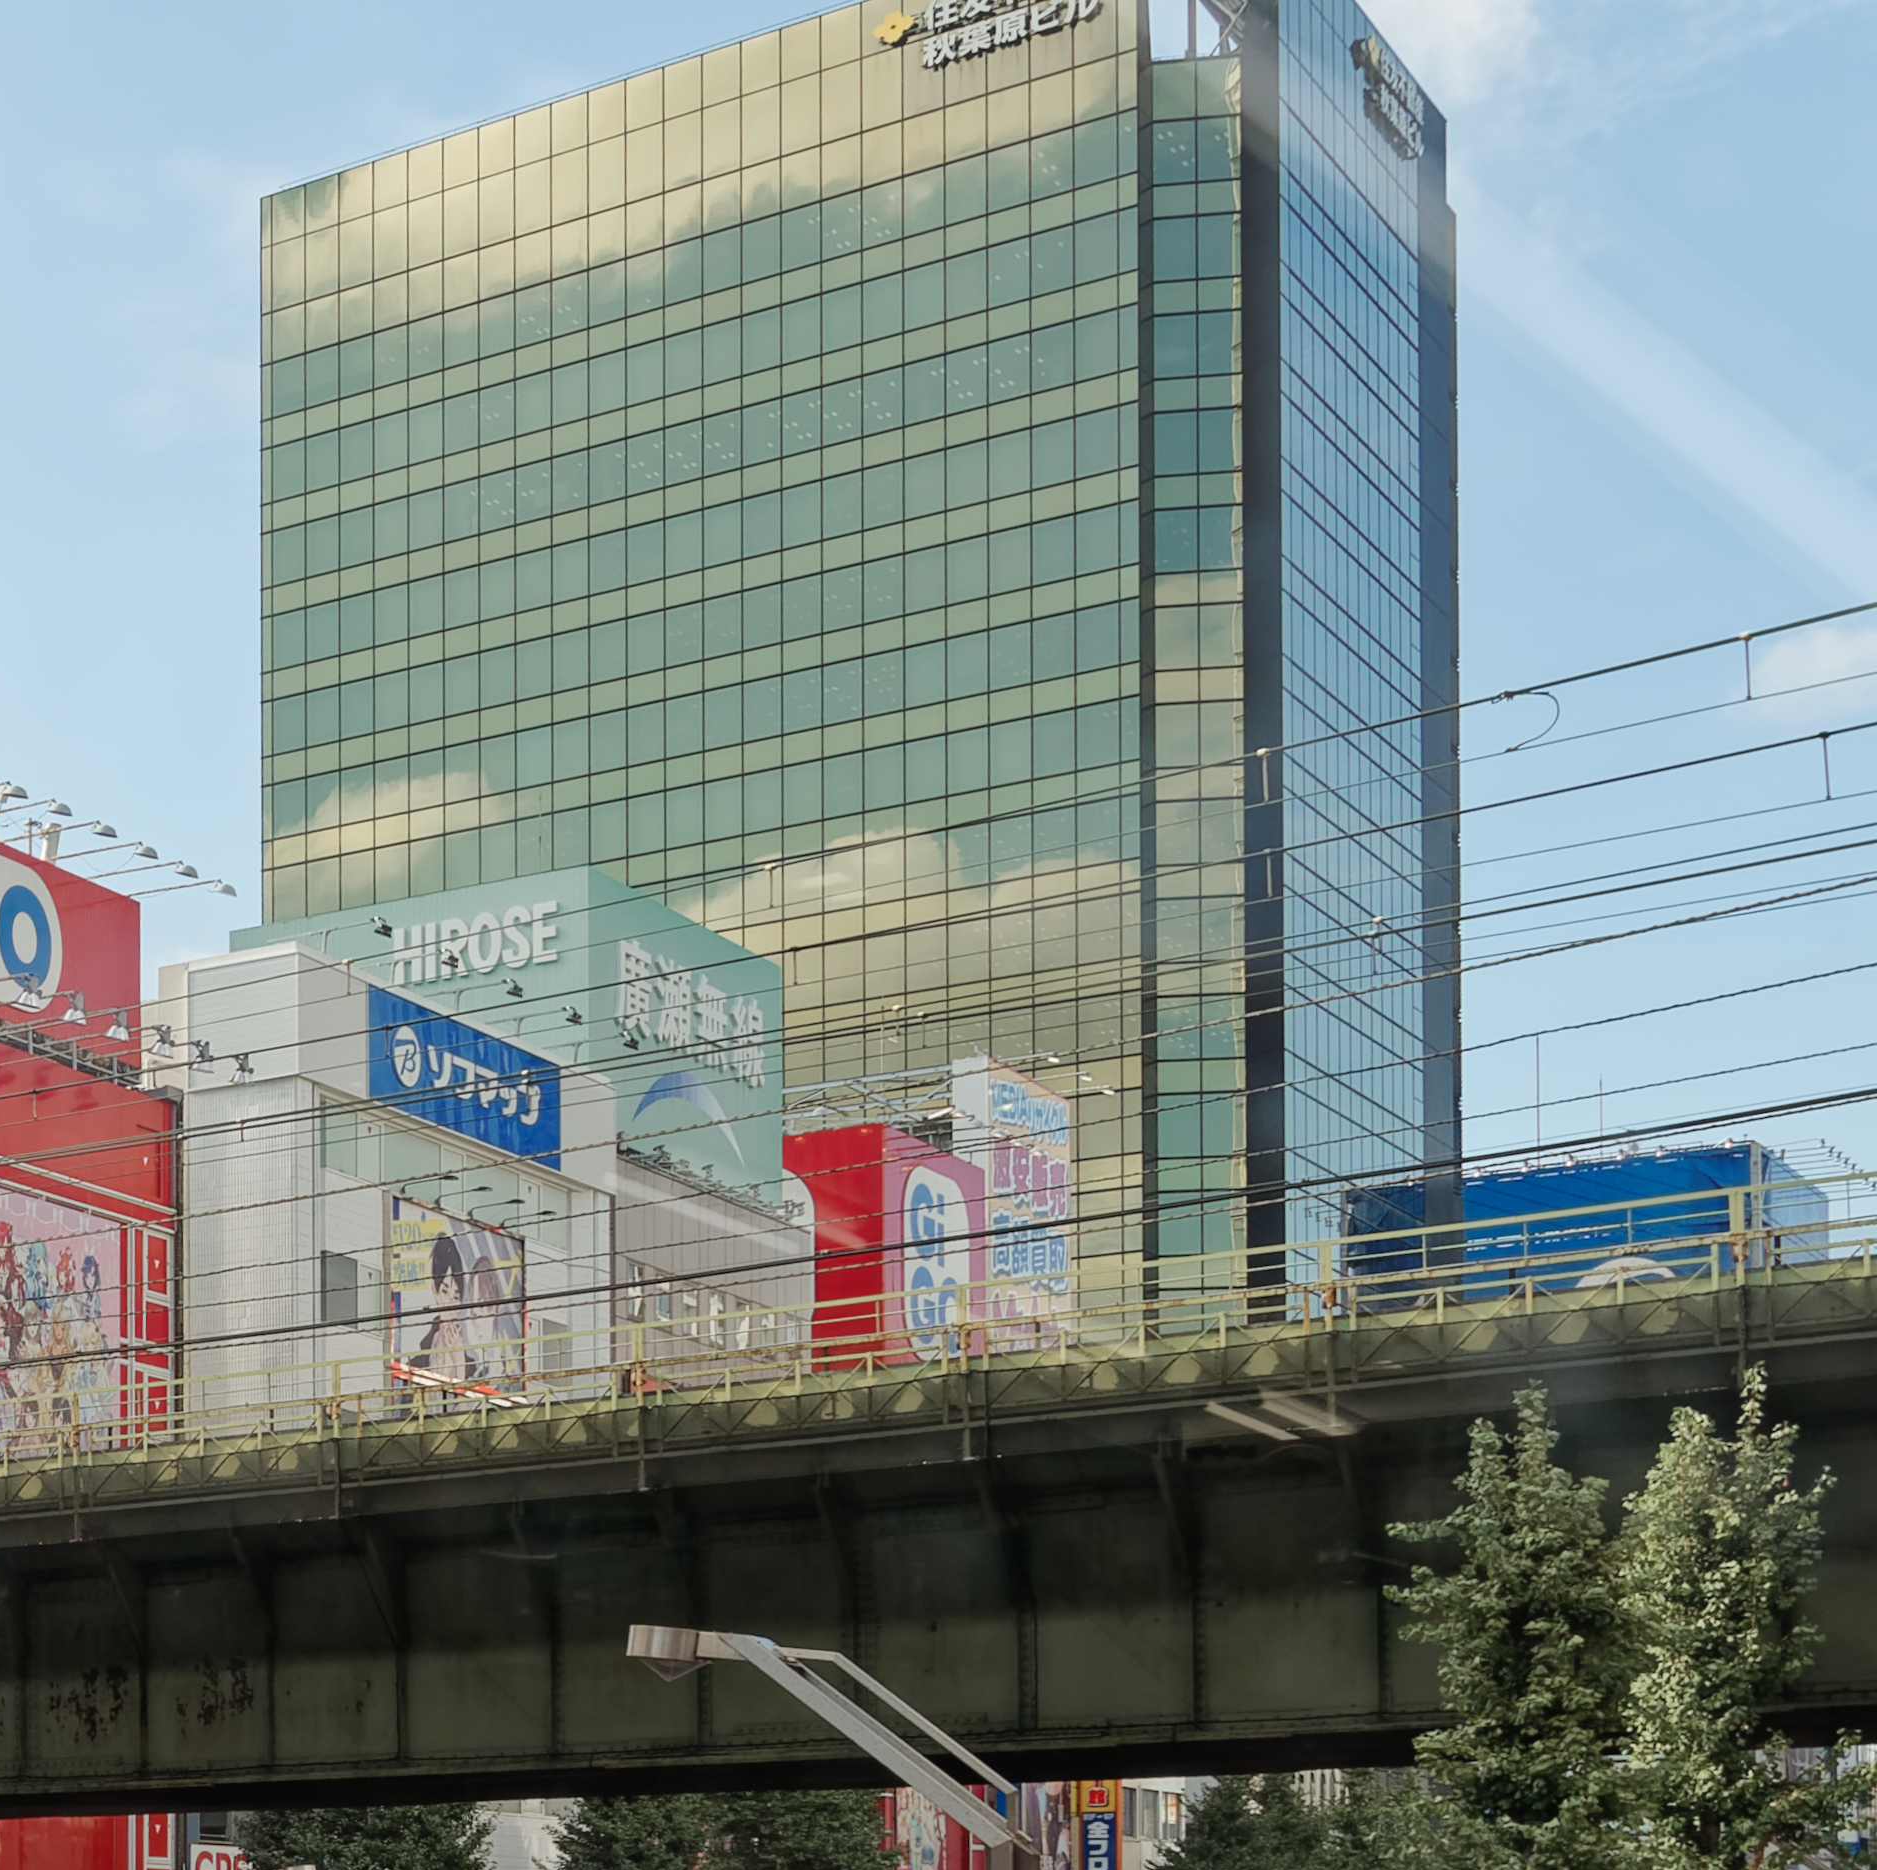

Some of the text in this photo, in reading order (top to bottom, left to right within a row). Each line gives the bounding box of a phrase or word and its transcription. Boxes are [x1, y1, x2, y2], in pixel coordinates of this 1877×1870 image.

[392, 900, 560, 987] HIROSE
[427, 1044, 540, 1126] ソフマップ
